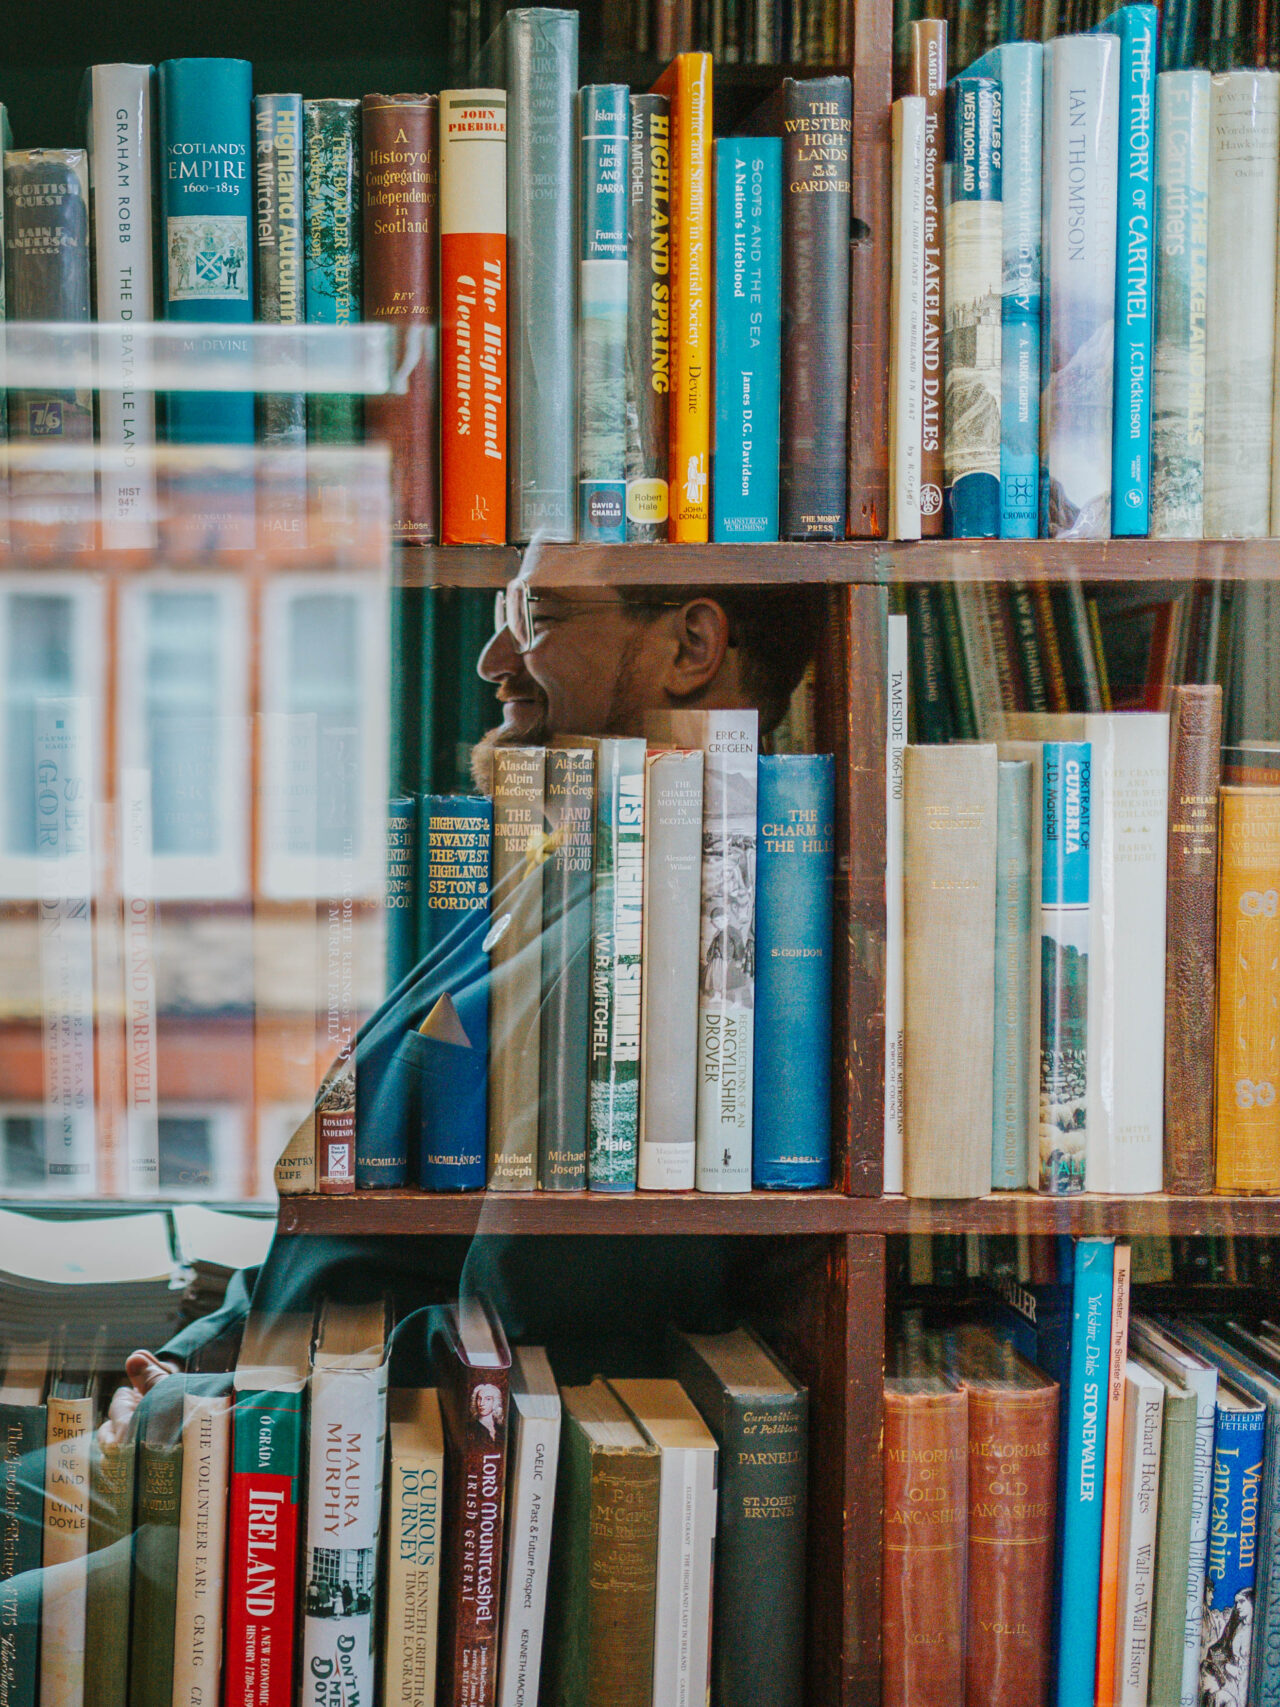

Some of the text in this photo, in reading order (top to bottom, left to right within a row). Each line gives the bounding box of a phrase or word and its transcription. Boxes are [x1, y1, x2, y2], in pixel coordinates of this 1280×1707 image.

[449, 121, 506, 133] PREBBLE
[461, 110, 495, 120] JOHN
[963, 92, 975, 191] WESTMORLAND
[992, 91, 1001, 168] CASTLES OF
[169, 160, 246, 179] EMPIRE
[735, 159, 746, 168] A
[1068, 89, 1086, 261] IAN THOMPSON
[1127, 31, 1150, 326] THE PRIORY OF CARTMEL
[650, 113, 670, 394] HIGHLAND SPRING
[734, 233, 746, 298] Lifeblood
[750, 158, 763, 348] SCOTS AND THE SEA
[923, 112, 940, 452] The Story of the LAKELAND DALES
[455, 275, 476, 436] Clearances
[479, 259, 502, 460] The Highland
[742, 371, 752, 496] James D.G. Davidson
[635, 494, 662, 503] Robert
[639, 502, 657, 511] Hale
[709, 743, 753, 753] CREGEEN
[716, 730, 749, 741] ERIC R.
[891, 671, 904, 800] TAMESIDE 1066-1700
[1066, 761, 1078, 855] CUMBRIA
[1082, 761, 1090, 849] PORTRAIT OF
[429, 866, 488, 879] HIGHLANDS
[429, 897, 487, 910] GORDON
[704, 1014, 719, 1083] DROVER
[721, 1017, 736, 1124] ARGYLLSHIRE
[494, 1154, 532, 1164] Michael
[495, 1166, 532, 1178] Joseph
[1080, 1293, 1103, 1502] Yorkshire Dales STONEWALLER
[1113, 1382, 1121, 1401] Side
[1114, 1349, 1122, 1380] Sinister
[52, 1426, 86, 1439] SPIRIT
[58, 1412, 82, 1424] THE
[1139, 1401, 1160, 1514] Richard Hodges
[50, 1502, 83, 1514] LYNN
[324, 1422, 343, 1536] MURPHY
[344, 1432, 361, 1530] MAURA
[399, 1467, 417, 1564] JOURNEY
[419, 1469, 436, 1566] CURIOUS
[1211, 1448, 1239, 1580] Lancashire
[1239, 1462, 1262, 1569] Victorian
[48, 1516, 86, 1528] DOYLE
[246, 1488, 285, 1617] IRELAND
[1126, 1637, 1147, 1689] History
